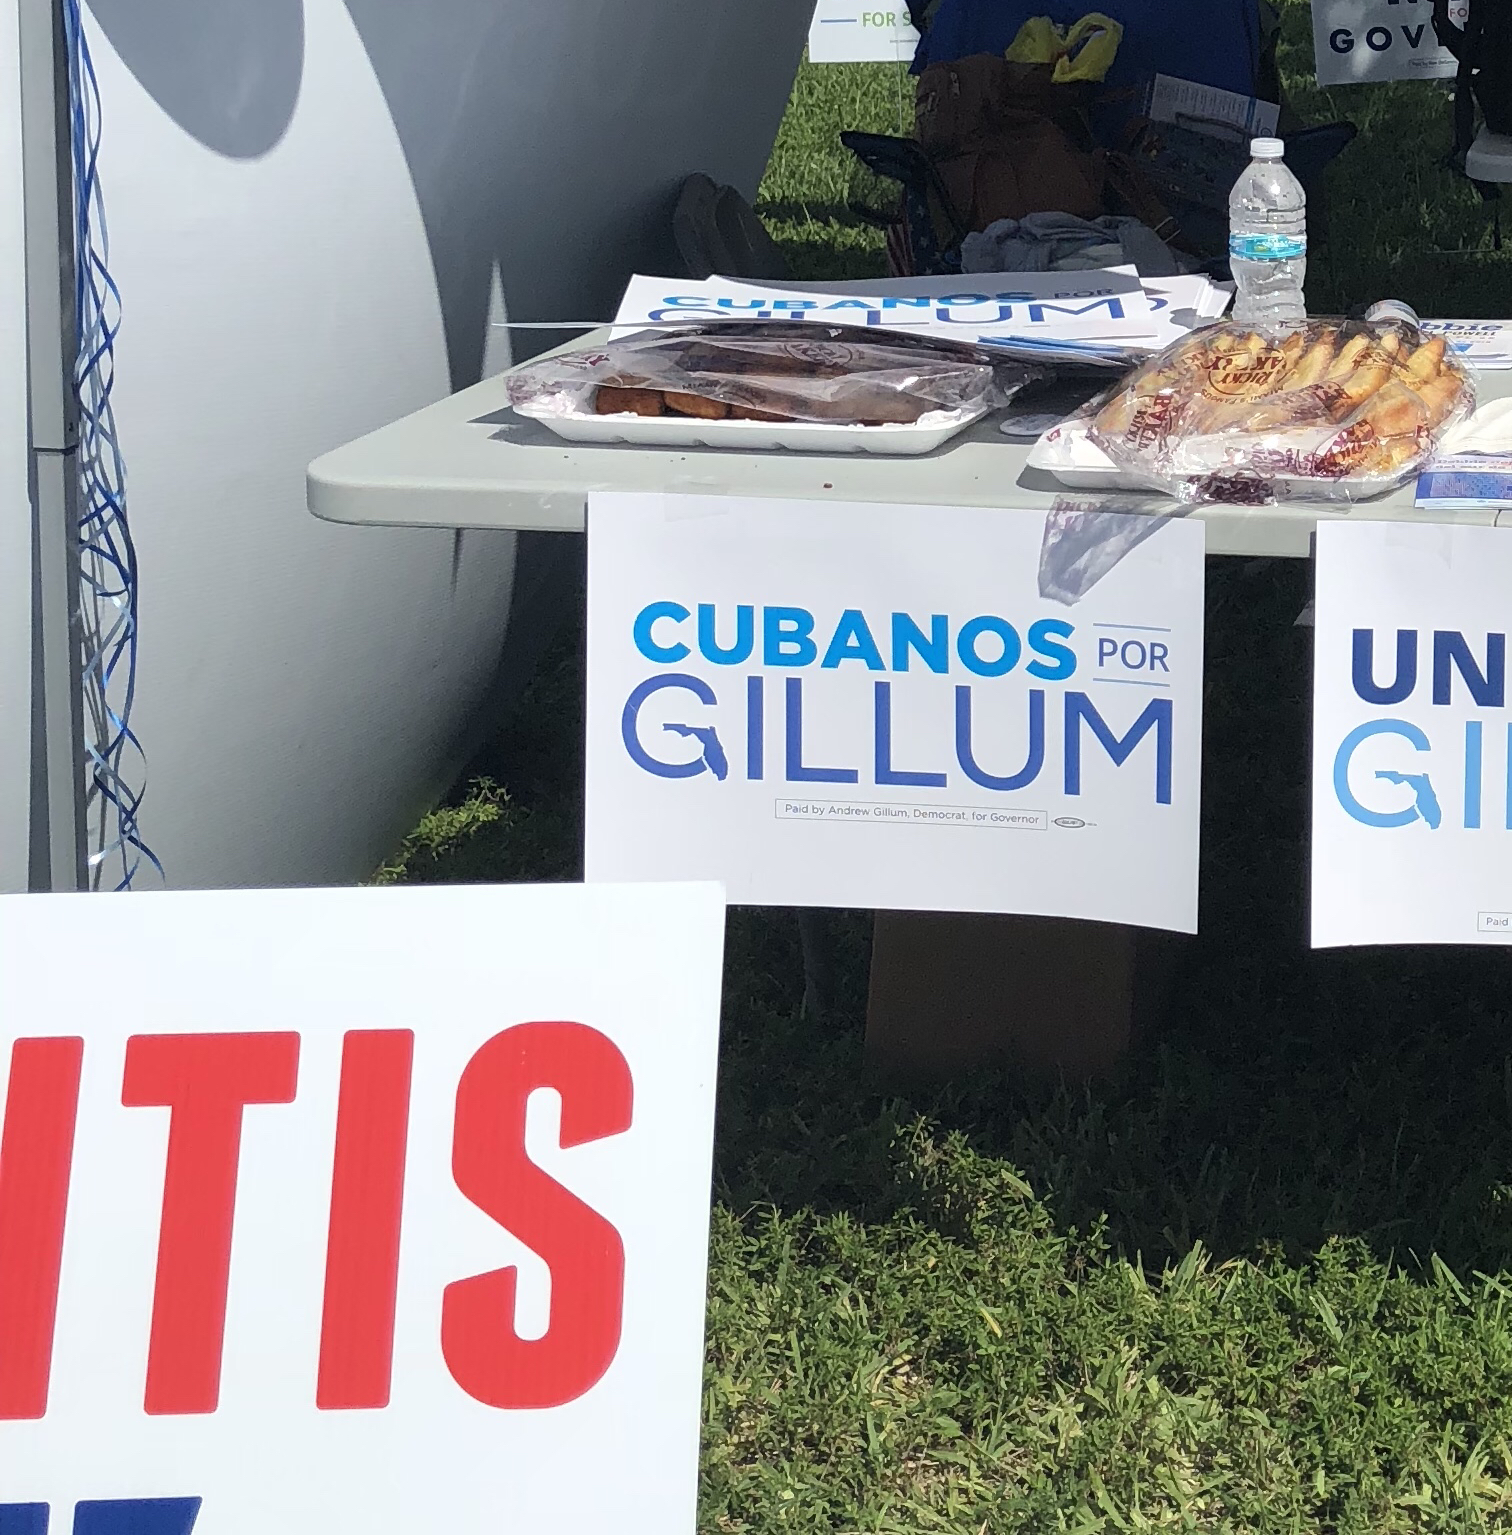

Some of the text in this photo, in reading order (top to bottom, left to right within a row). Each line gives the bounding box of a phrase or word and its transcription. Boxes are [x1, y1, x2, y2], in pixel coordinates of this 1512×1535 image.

[862, 11, 896, 27] FOR
[663, 288, 1112, 312] CUBANOS POR
[633, 600, 1170, 680] CUBANOS POR
[621, 672, 1173, 805] GILLUM
[785, 804, 1039, 824] Paid by Andrew Gillum, Democrat, for Governor
[1486, 917, 1509, 927] Paid
